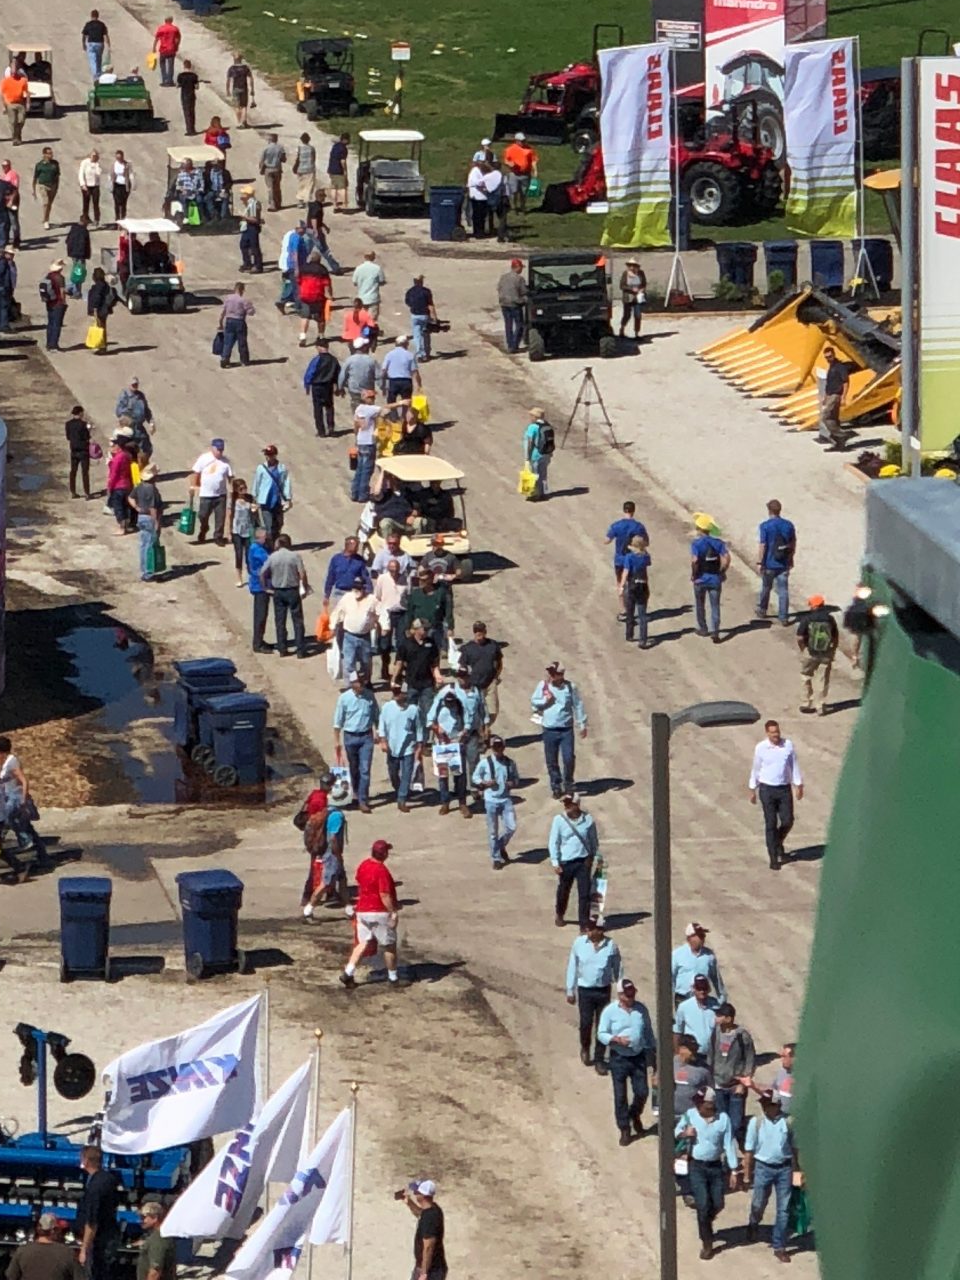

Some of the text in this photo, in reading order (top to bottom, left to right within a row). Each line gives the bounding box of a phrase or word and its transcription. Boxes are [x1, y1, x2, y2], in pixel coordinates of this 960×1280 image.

[645, 53, 663, 141] CLAAS
[830, 48, 849, 136] CLAAS
[934, 72, 960, 239] CLAAS
